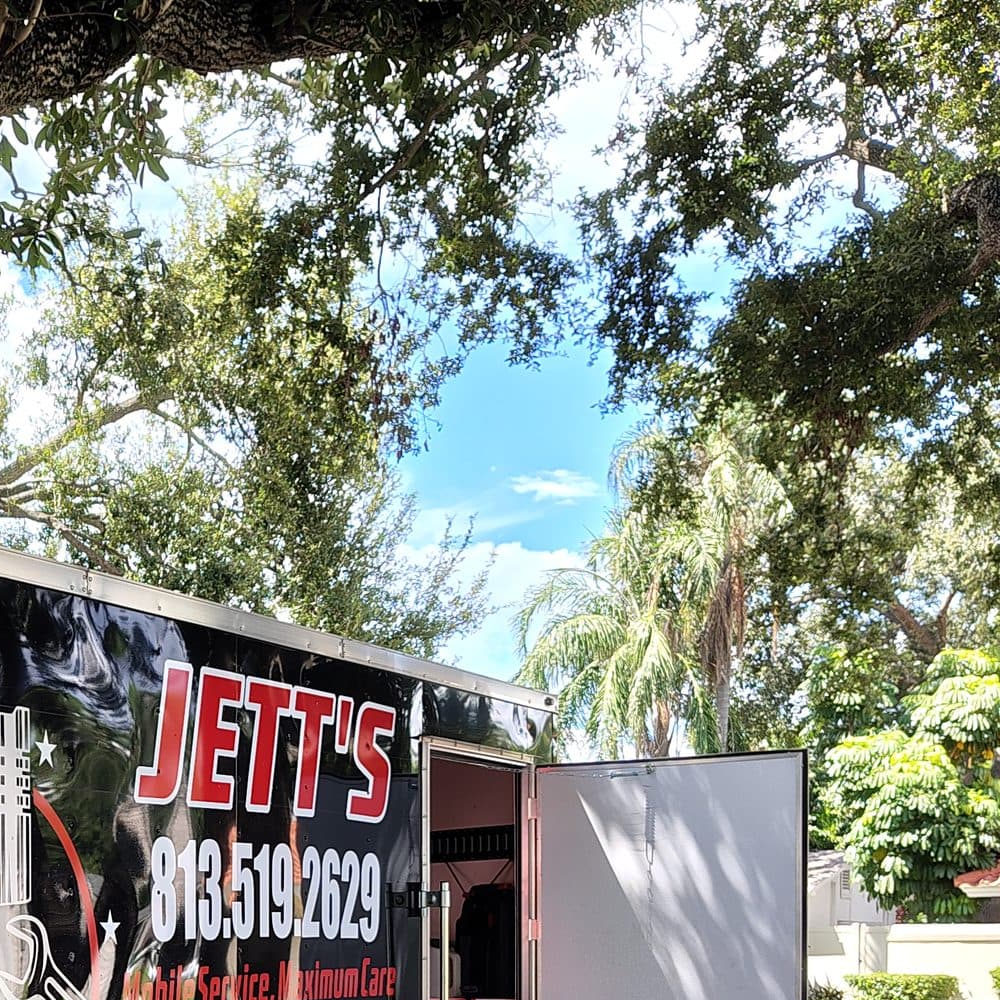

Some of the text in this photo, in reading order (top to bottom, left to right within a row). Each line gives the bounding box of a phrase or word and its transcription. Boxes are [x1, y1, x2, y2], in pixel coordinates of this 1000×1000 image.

[134, 659, 396, 823] JETT'S
[151, 837, 381, 943] 813.519.2629
[360, 957, 397, 998] Care
